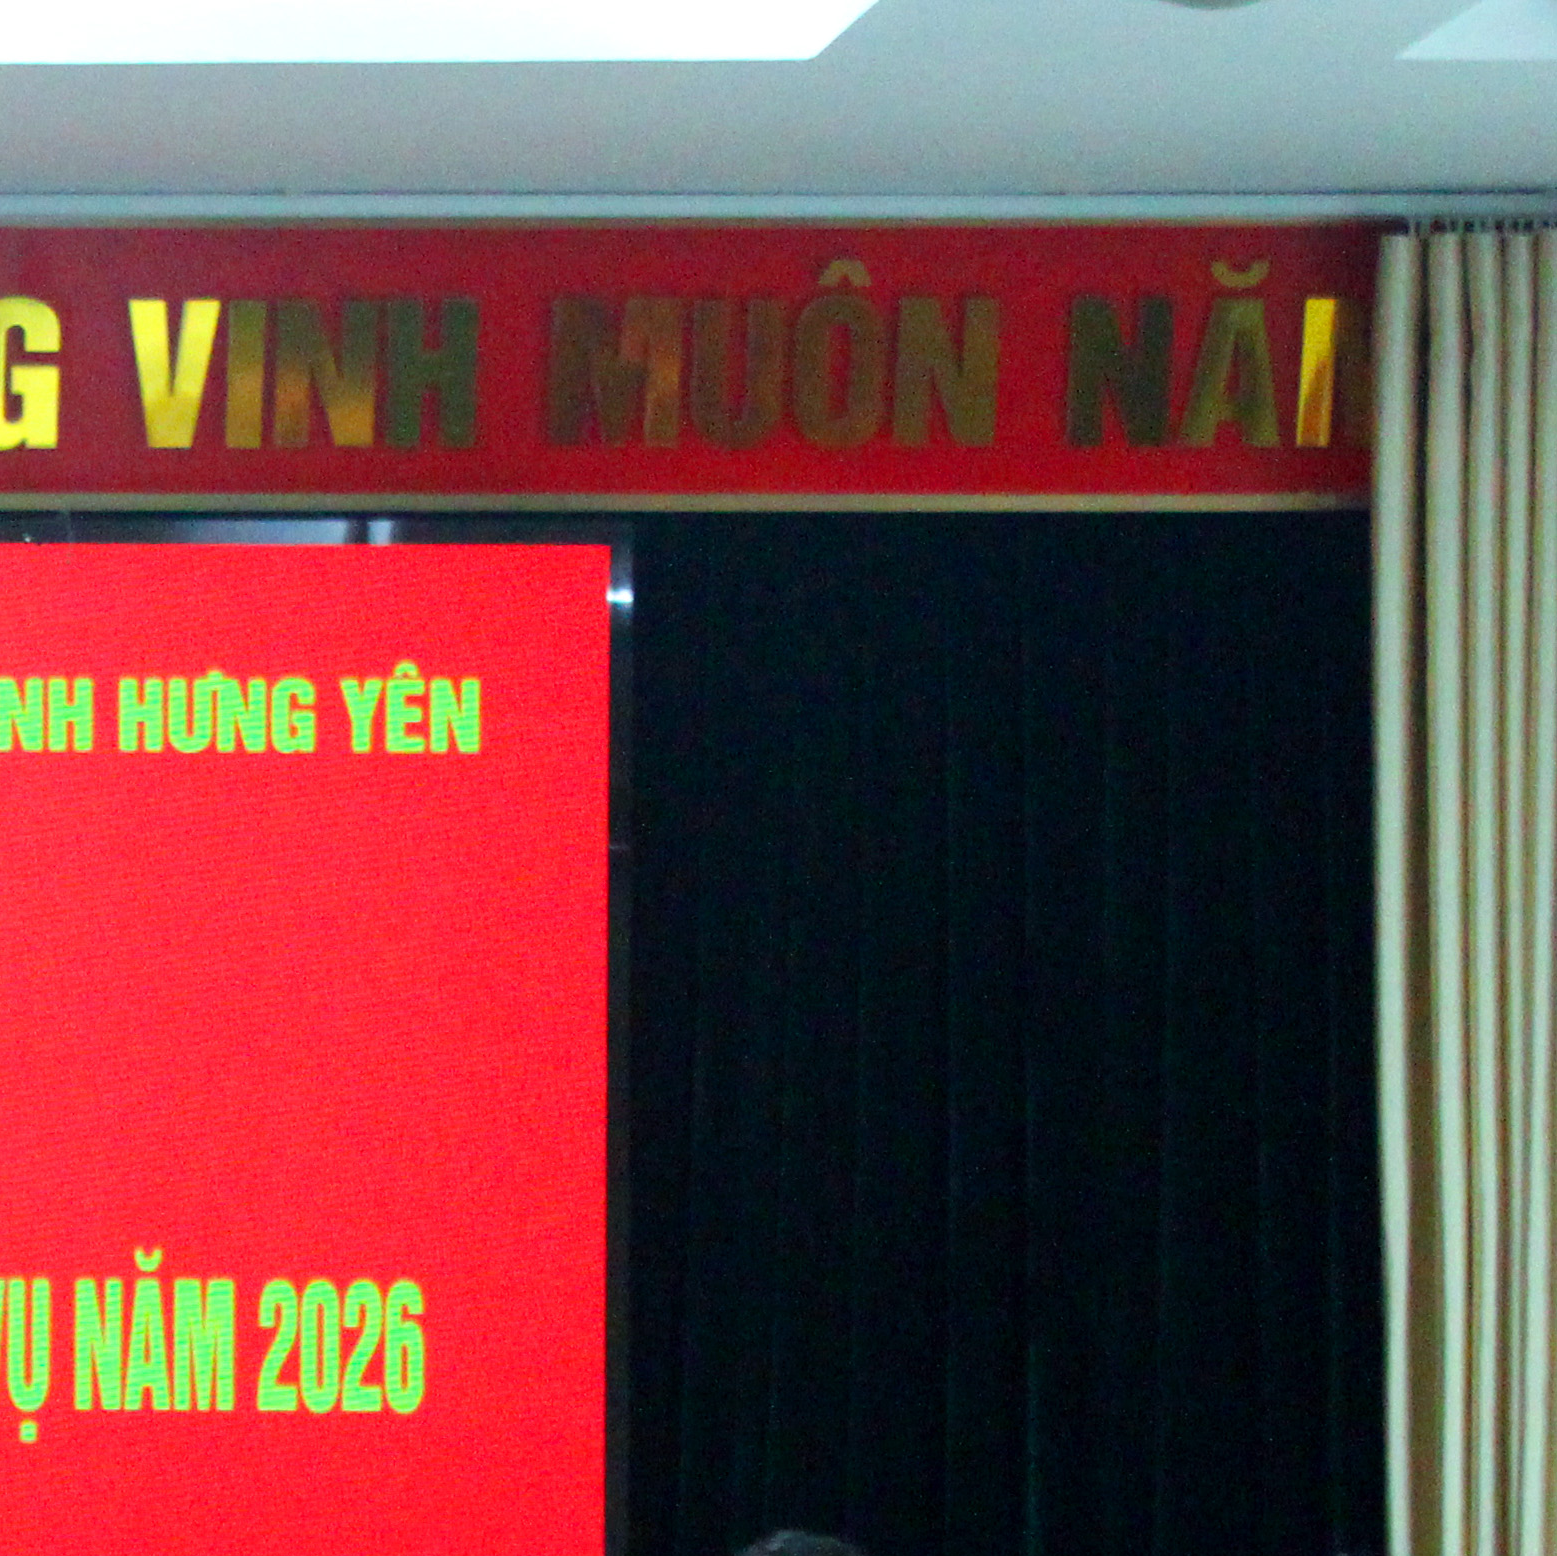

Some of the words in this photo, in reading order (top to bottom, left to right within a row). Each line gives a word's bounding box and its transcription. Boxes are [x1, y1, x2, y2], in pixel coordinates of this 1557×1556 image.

[128, 298, 480, 449] VINH
[545, 258, 1001, 449] MUÔN
[117, 669, 317, 754] HƯNG
[339, 659, 482, 754] YÊN
[73, 1248, 236, 1412] NĂM
[256, 1278, 426, 1415] 2026
